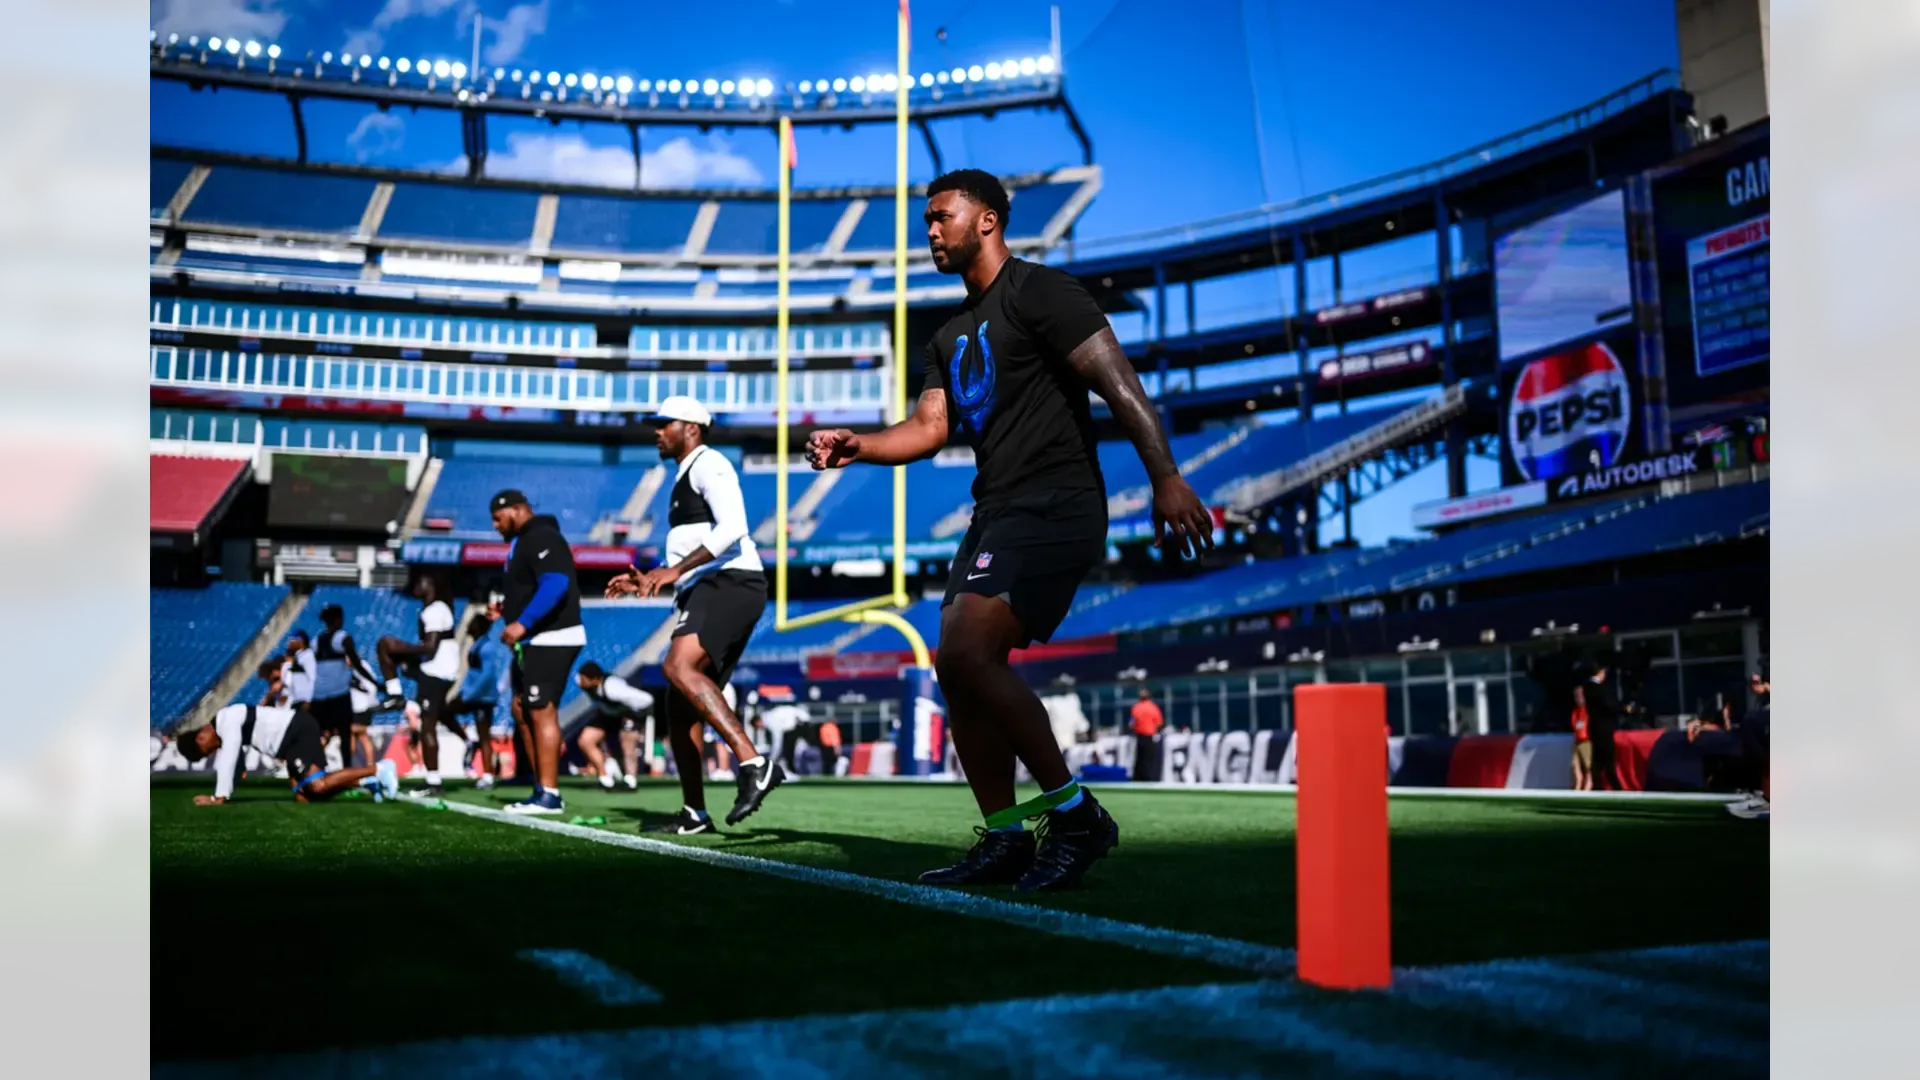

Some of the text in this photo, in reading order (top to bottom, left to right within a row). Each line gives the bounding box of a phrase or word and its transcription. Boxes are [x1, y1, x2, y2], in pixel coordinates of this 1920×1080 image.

[1516, 385, 1622, 442] PEPSI
[1583, 453, 1697, 492] AUTODESK
[1161, 730, 1297, 784] ENGLA
